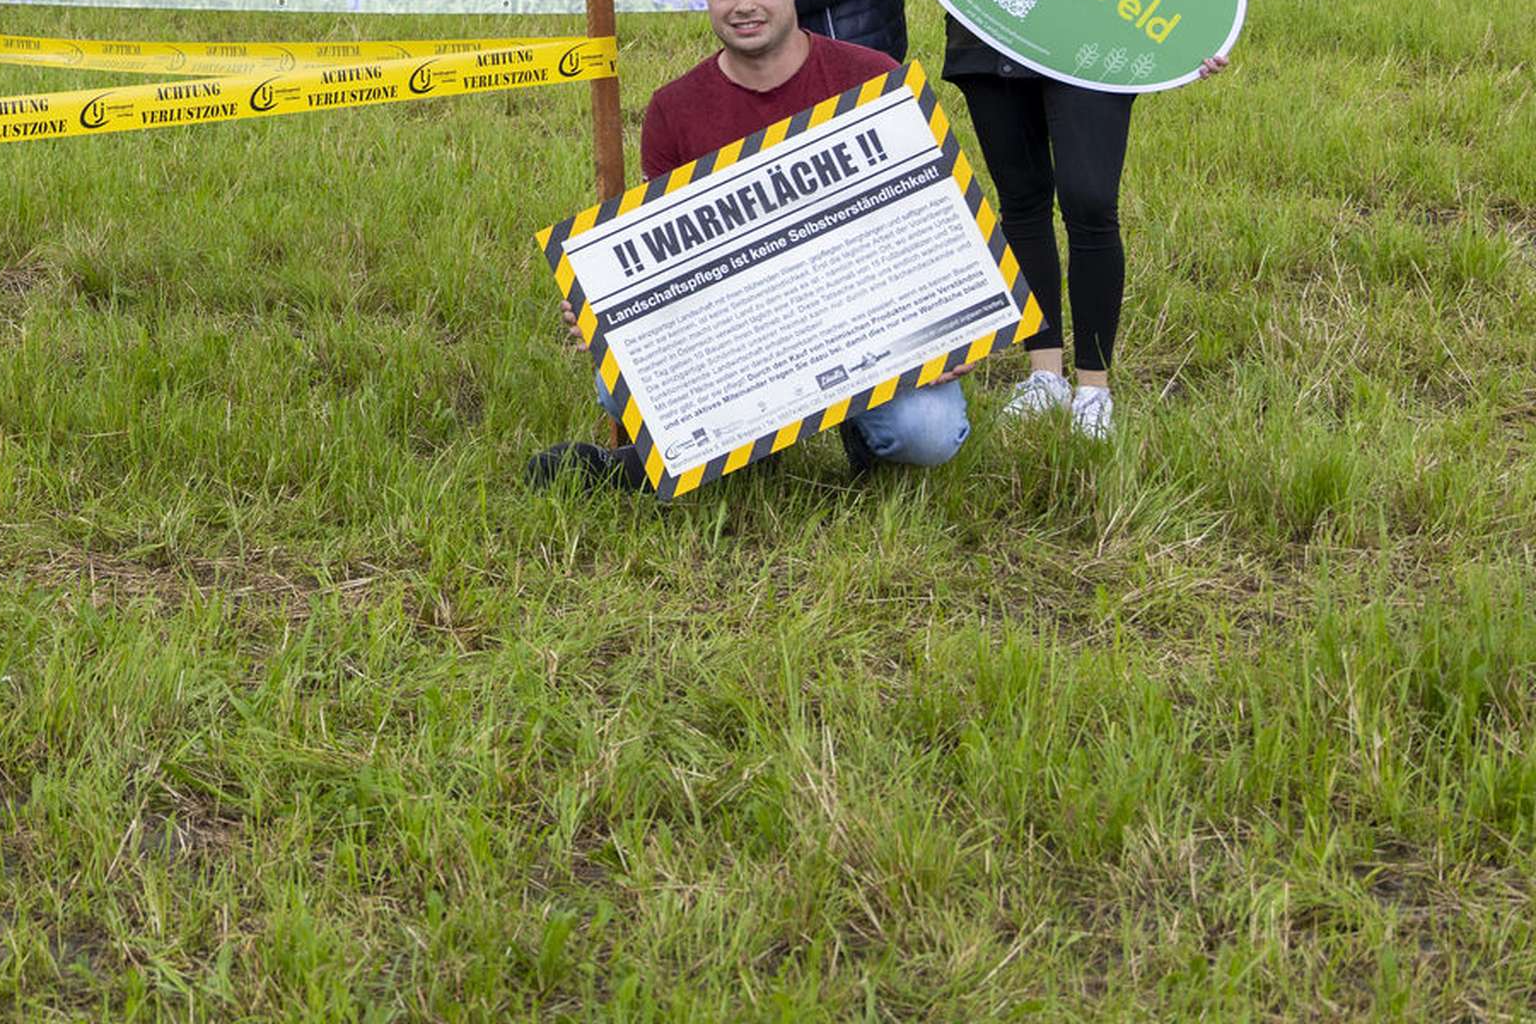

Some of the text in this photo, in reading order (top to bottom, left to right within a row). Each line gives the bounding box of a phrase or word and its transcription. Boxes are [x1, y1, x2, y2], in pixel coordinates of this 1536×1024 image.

[476, 49, 533, 67] ACHTUNG
[320, 65, 382, 85] ACHTUNG
[463, 68, 549, 90] VERLUSTZONE
[155, 83, 221, 102] ACHTUNG
[308, 85, 398, 108] VERLUSTZONE
[141, 103, 239, 125] VERLUSTZONE
[611, 127, 889, 278] !! WARNFLÄCHE !!
[606, 164, 940, 326] Landschaftspflege ist keine Selbstverständlichkeit!
